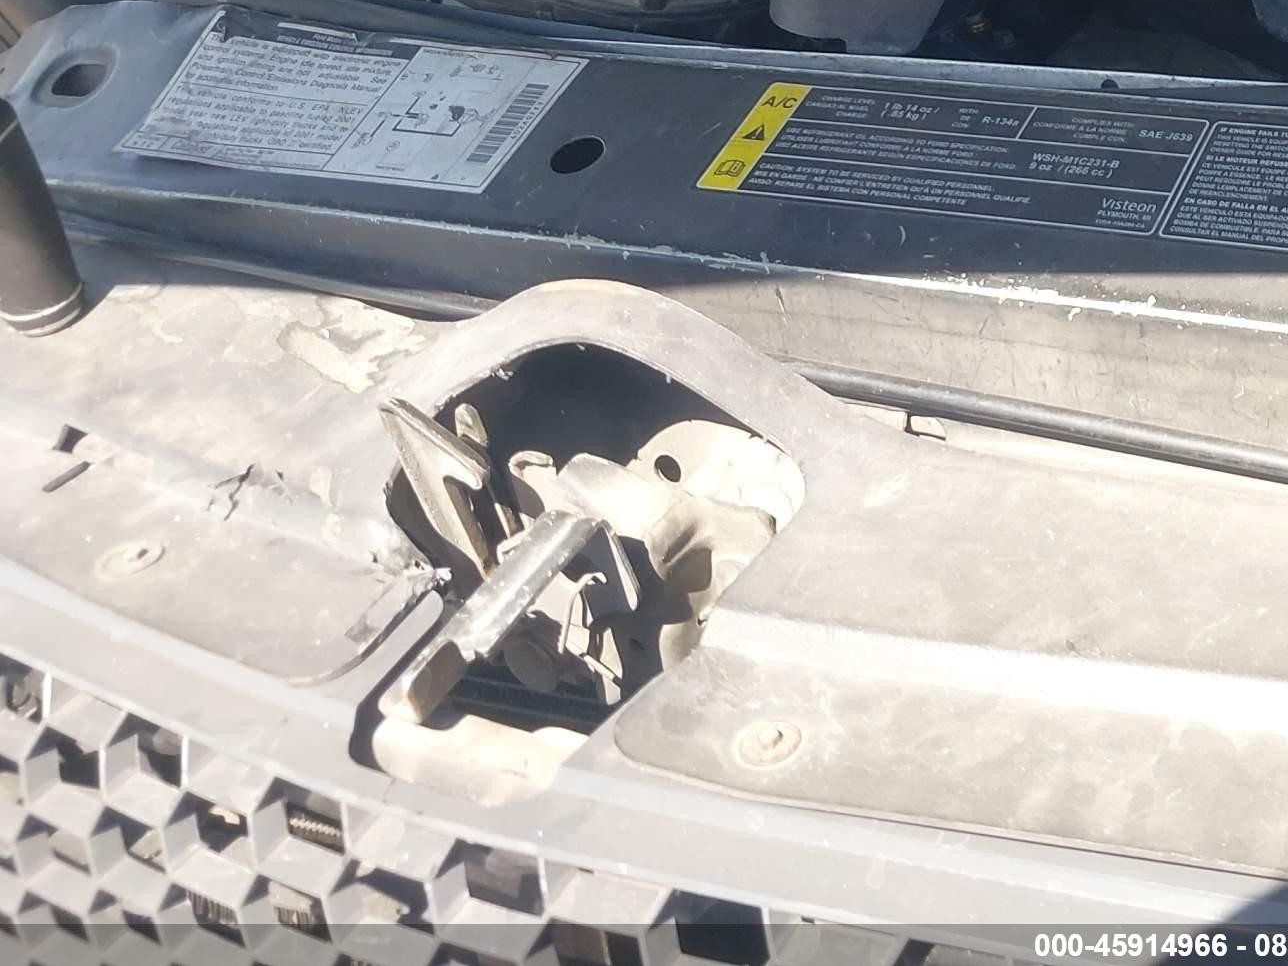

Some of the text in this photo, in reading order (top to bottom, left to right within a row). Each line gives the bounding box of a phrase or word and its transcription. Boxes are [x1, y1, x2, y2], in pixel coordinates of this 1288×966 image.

[367, 76, 388, 86] See
[760, 94, 800, 109] A/C
[979, 115, 1021, 127] R-134a
[1136, 128, 1195, 142] SAE J639
[1227, 126, 1258, 135] ENGINE
[1256, 128, 1279, 137] FAILS
[1097, 197, 1159, 214] Visteon
[1182, 196, 1196, 204] EN
[1194, 197, 1219, 206] CASO
[1229, 201, 1256, 210] FALLA
[1254, 203, 1269, 211] EN
[1267, 205, 1281, 213] EL
